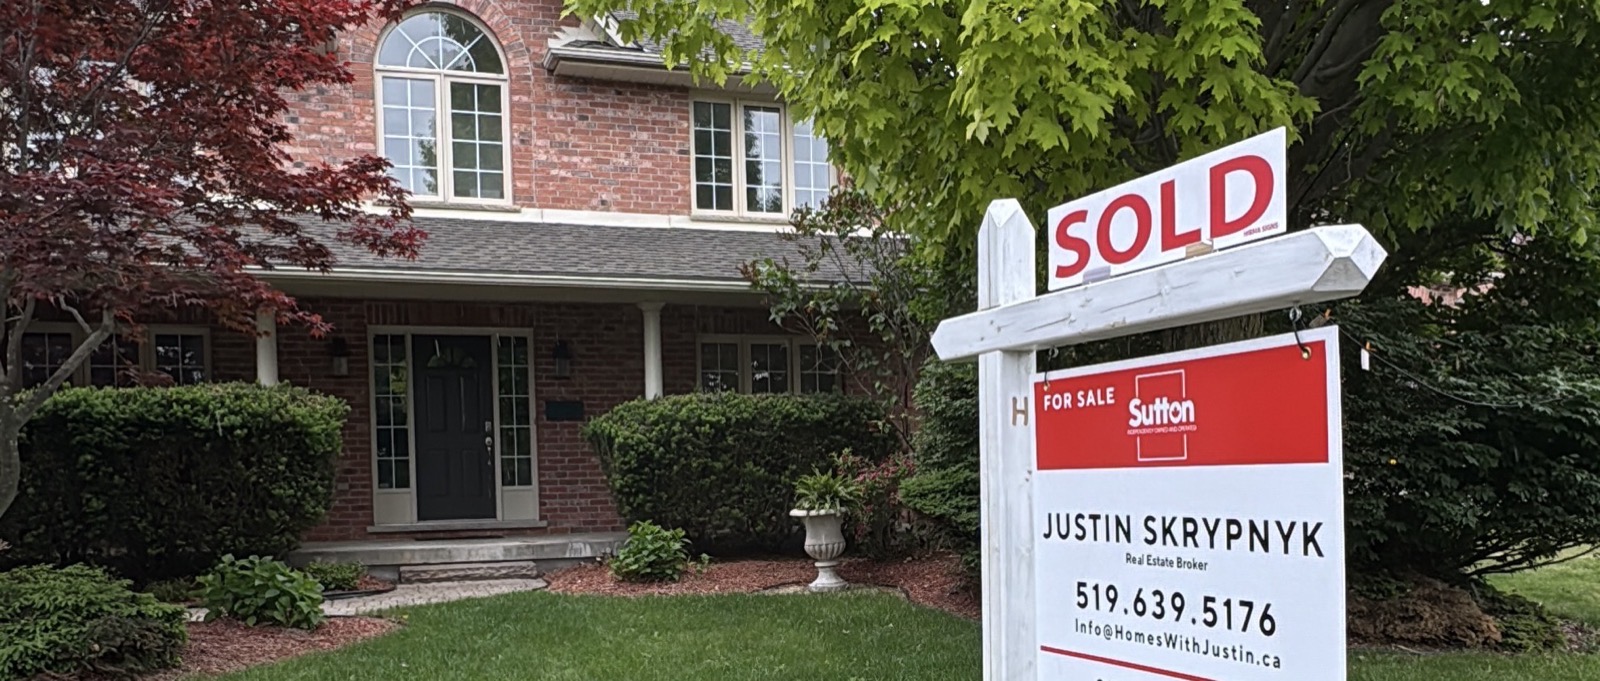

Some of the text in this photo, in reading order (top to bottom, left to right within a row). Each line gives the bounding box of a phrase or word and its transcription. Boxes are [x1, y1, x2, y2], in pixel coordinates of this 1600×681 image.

[1055, 154, 1274, 279] SOLD
[1262, 222, 1278, 232] SIGNS
[1012, 397, 1028, 426] H
[1043, 387, 1115, 411] FOR SALE
[1128, 397, 1195, 427] Sutton
[1043, 512, 1325, 558] JUSTIN SKRYPNYK
[1126, 552, 1208, 571] Real Estate Broker
[1076, 581, 1276, 637] 519.639.5176
[1075, 618, 1281, 669] Info@HomesWithJustin.ca
